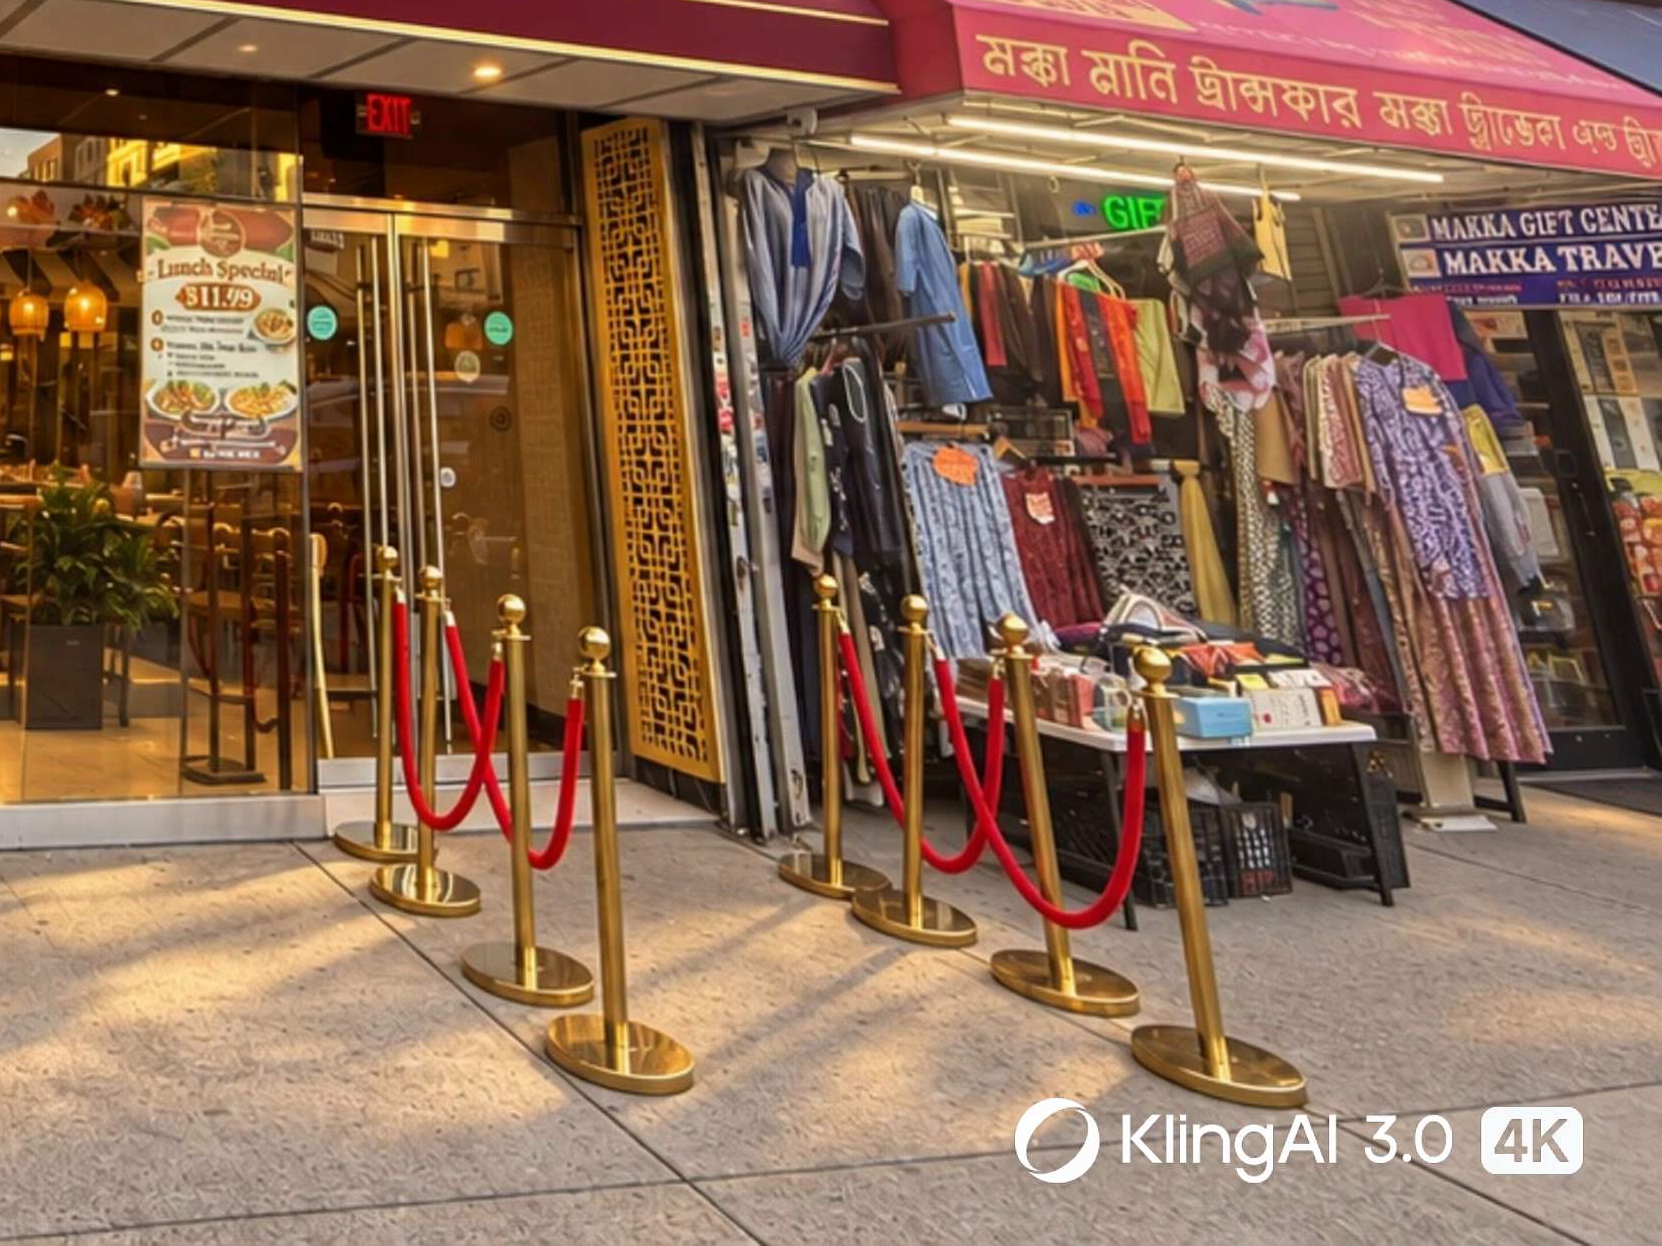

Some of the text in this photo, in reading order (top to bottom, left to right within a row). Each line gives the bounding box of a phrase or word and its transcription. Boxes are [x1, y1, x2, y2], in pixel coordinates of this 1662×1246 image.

[366, 93, 411, 137] EXIT
[1431, 211, 1516, 242] MAKKA
[1519, 209, 1577, 238] GIFT
[157, 257, 284, 285] Lunch Special
[1442, 246, 1557, 276] MAKKA
